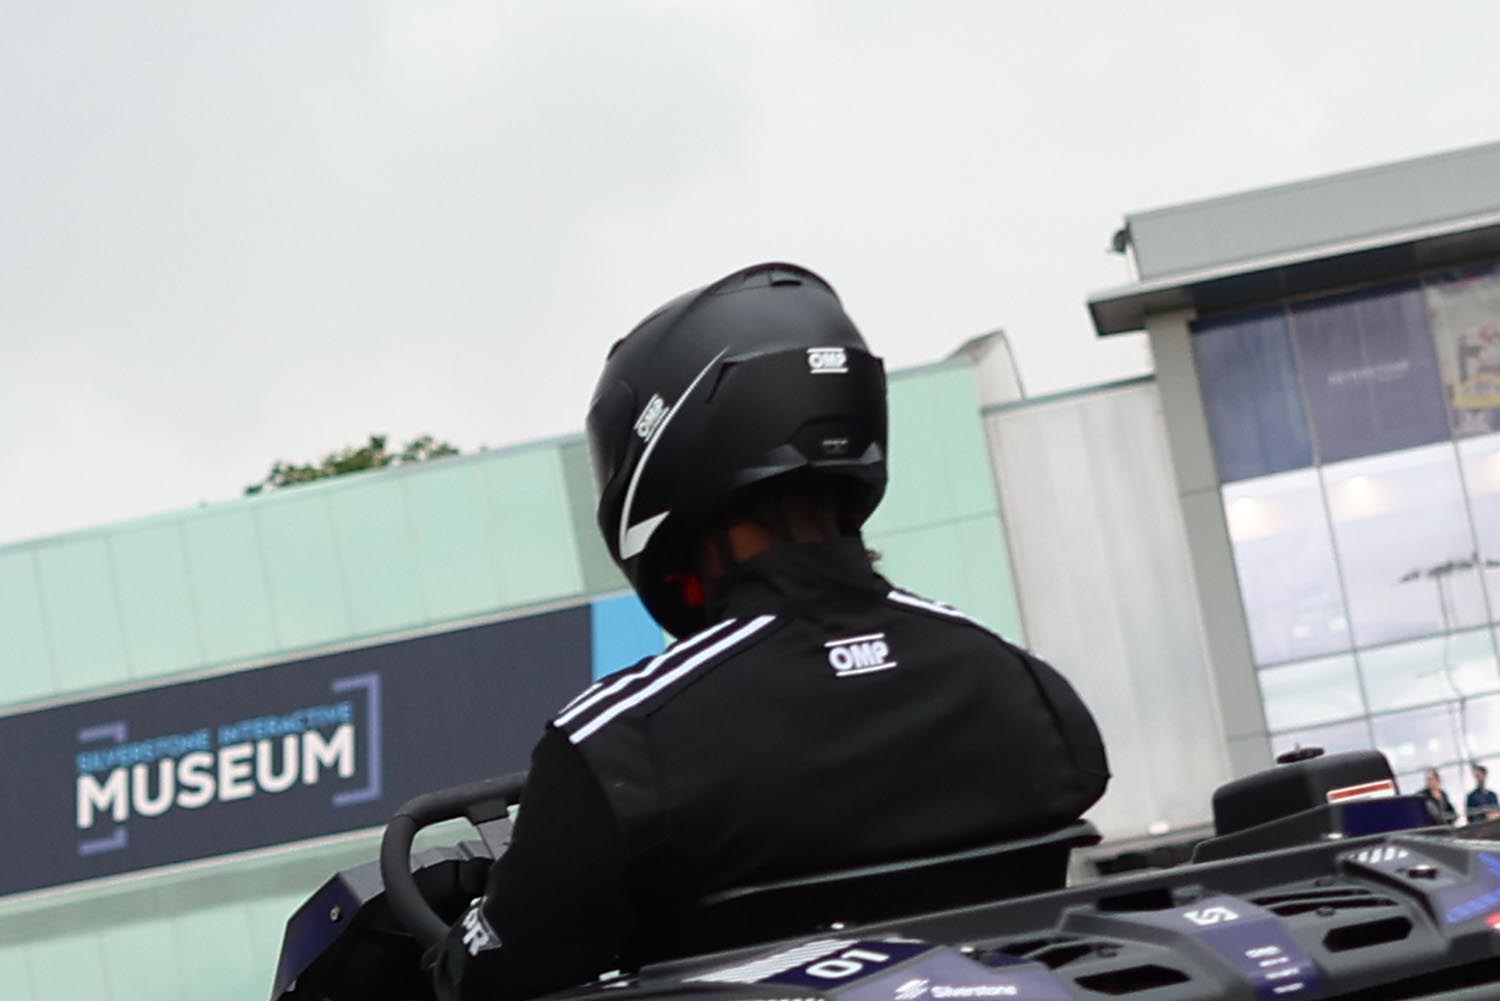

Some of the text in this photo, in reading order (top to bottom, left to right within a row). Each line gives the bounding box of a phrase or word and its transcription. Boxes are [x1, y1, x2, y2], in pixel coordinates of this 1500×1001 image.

[807, 352, 847, 369] OMP
[828, 640, 888, 671] OMP
[76, 724, 355, 829] MUSEUM
[805, 949, 890, 979] 01
